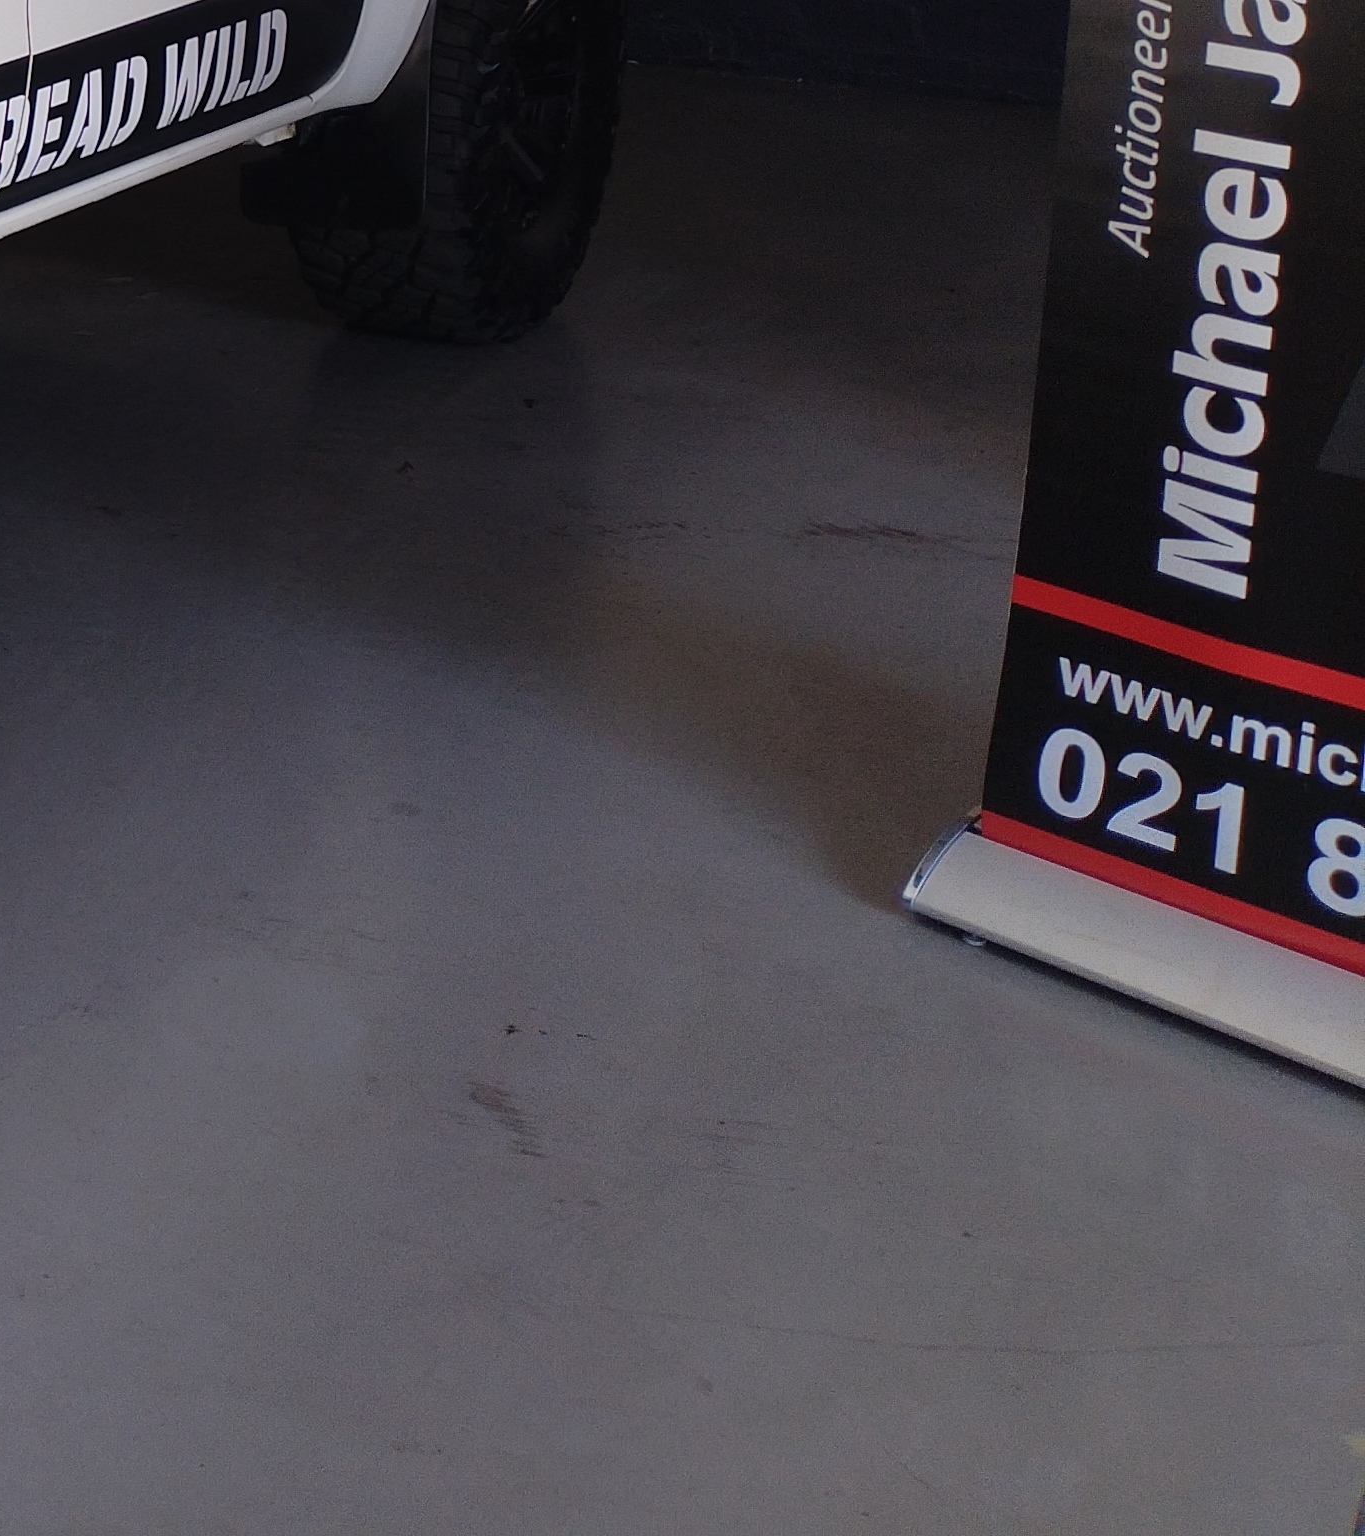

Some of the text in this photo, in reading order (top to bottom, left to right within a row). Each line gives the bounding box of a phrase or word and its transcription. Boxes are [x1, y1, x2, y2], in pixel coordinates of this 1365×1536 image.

[157, 9, 287, 130] WILD
[1157, 129, 1292, 600] Michael
[1058, 656, 1365, 794] www.mic
[1037, 727, 1246, 875] 021
